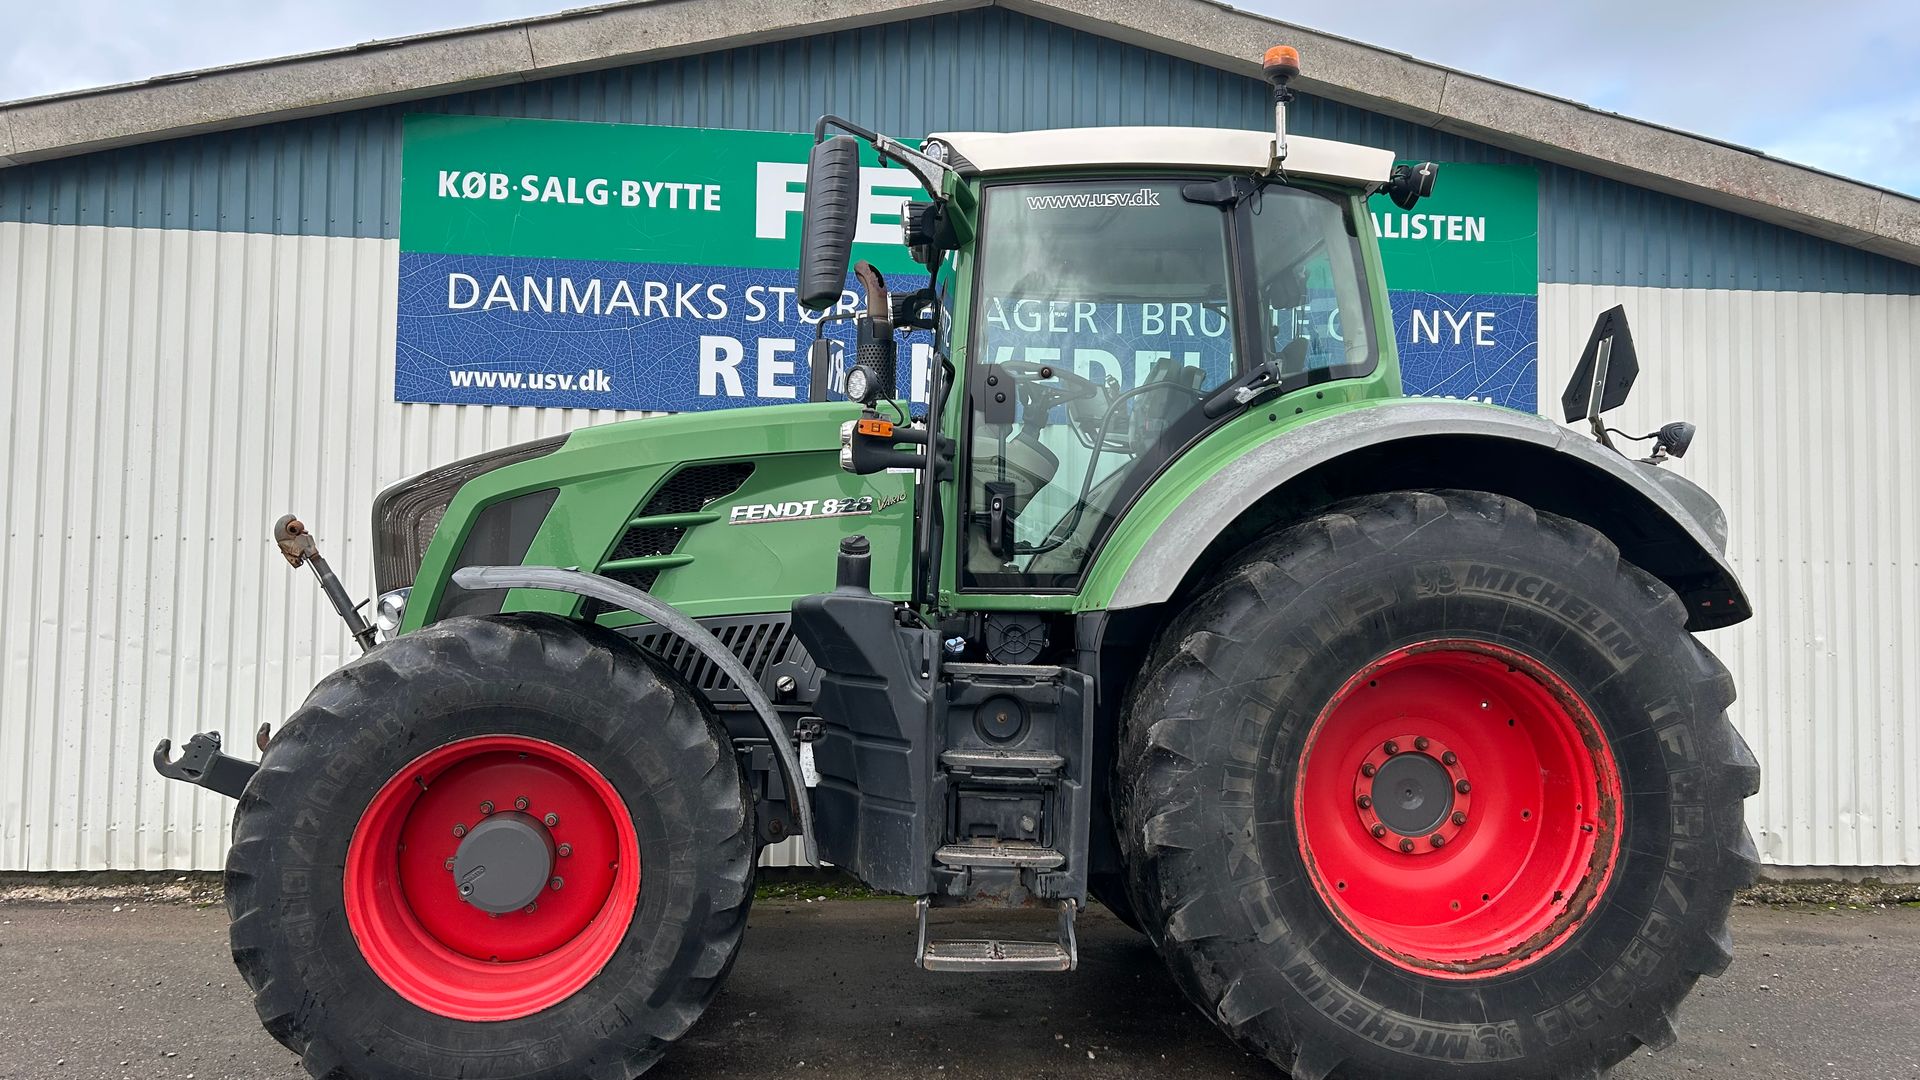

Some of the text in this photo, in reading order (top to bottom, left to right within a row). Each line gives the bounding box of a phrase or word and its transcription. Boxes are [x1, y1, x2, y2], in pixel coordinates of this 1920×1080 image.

[1027, 189, 1160, 209] www.usv.dk
[448, 273, 729, 320] DANMARKS
[986, 297, 1098, 334] AGER
[1412, 309, 1496, 346] NYE
[449, 369, 611, 393] www.usv.dk
[730, 500, 820, 521] FENDT
[821, 496, 873, 514] 828
[1463, 563, 1640, 662] MICHELIN
[1284, 960, 1470, 1060] MICHELIN
